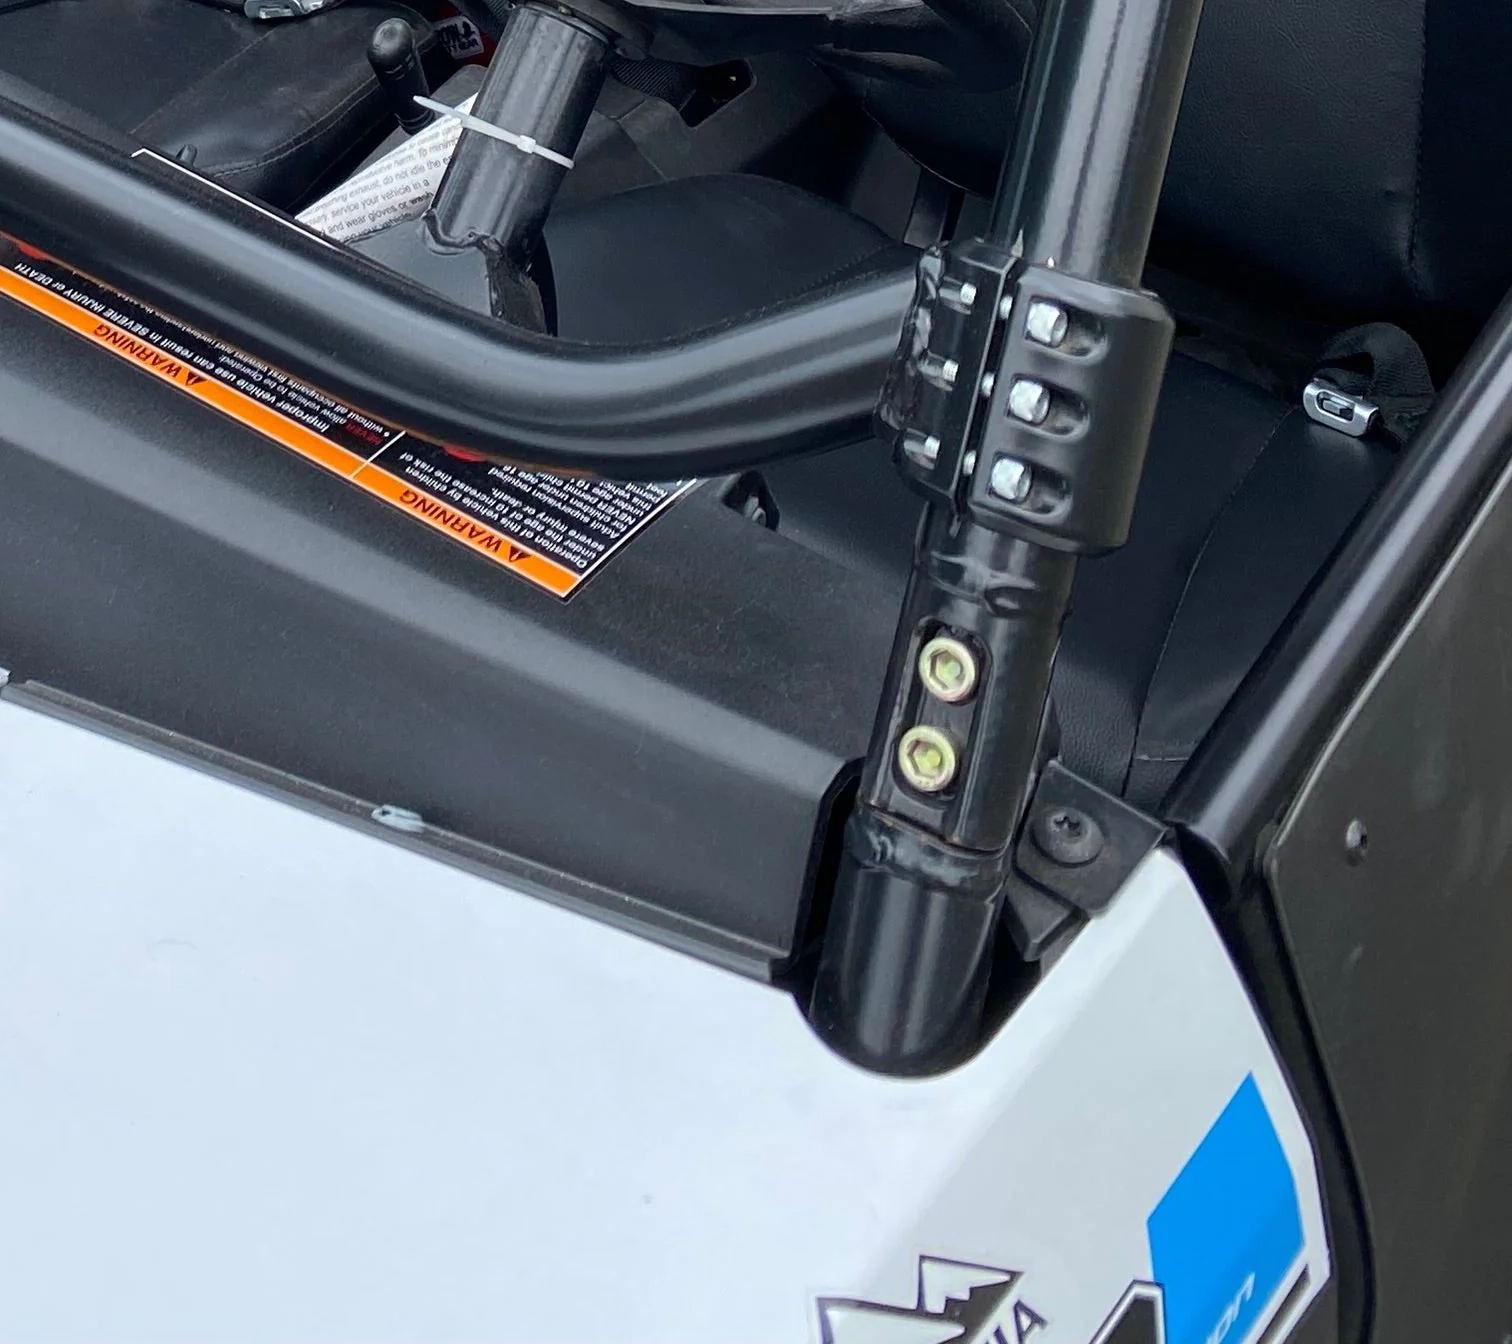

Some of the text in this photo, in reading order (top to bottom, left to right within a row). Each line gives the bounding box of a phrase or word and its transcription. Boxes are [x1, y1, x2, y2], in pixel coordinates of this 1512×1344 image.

[359, 194, 380, 209] your
[379, 183, 411, 201] vehicle
[325, 190, 434, 235] and wear gloves or wash
[14, 262, 53, 285] DEATH
[51, 281, 65, 290] or
[62, 288, 105, 312] INJURY
[103, 308, 149, 335] SEVERE
[149, 331, 162, 343] in
[160, 338, 193, 358] result
[93, 323, 182, 377] WARNING
[192, 355, 214, 369] can
[218, 354, 263, 381] Operated:
[214, 367, 236, 381] use
[263, 378, 277, 388] be
[236, 378, 276, 403] vehicle
[276, 384, 288, 394] to
[286, 378, 335, 407] occupants
[287, 390, 320, 411] vehicle
[275, 400, 329, 432] Improper
[319, 408, 347, 424] allow
[333, 404, 348, 413] all
[346, 411, 383, 433] without
[517, 471, 539, 484] age
[537, 481, 569, 500] under
[562, 482, 598, 504] permit
[575, 479, 644, 517] under age 10
[624, 482, 662, 503] permit
[399, 452, 596, 559] under the age of 10 increase the risk of
[487, 467, 619, 538] Adult supervision required
[569, 497, 611, 522] children
[596, 500, 636, 525] NEVER
[631, 496, 652, 510] this
[399, 489, 502, 552] WARNING
[405, 465, 587, 568] Operation of this vehicle by children
[491, 487, 604, 551] severe injury or death.
[610, 519, 627, 532] for
